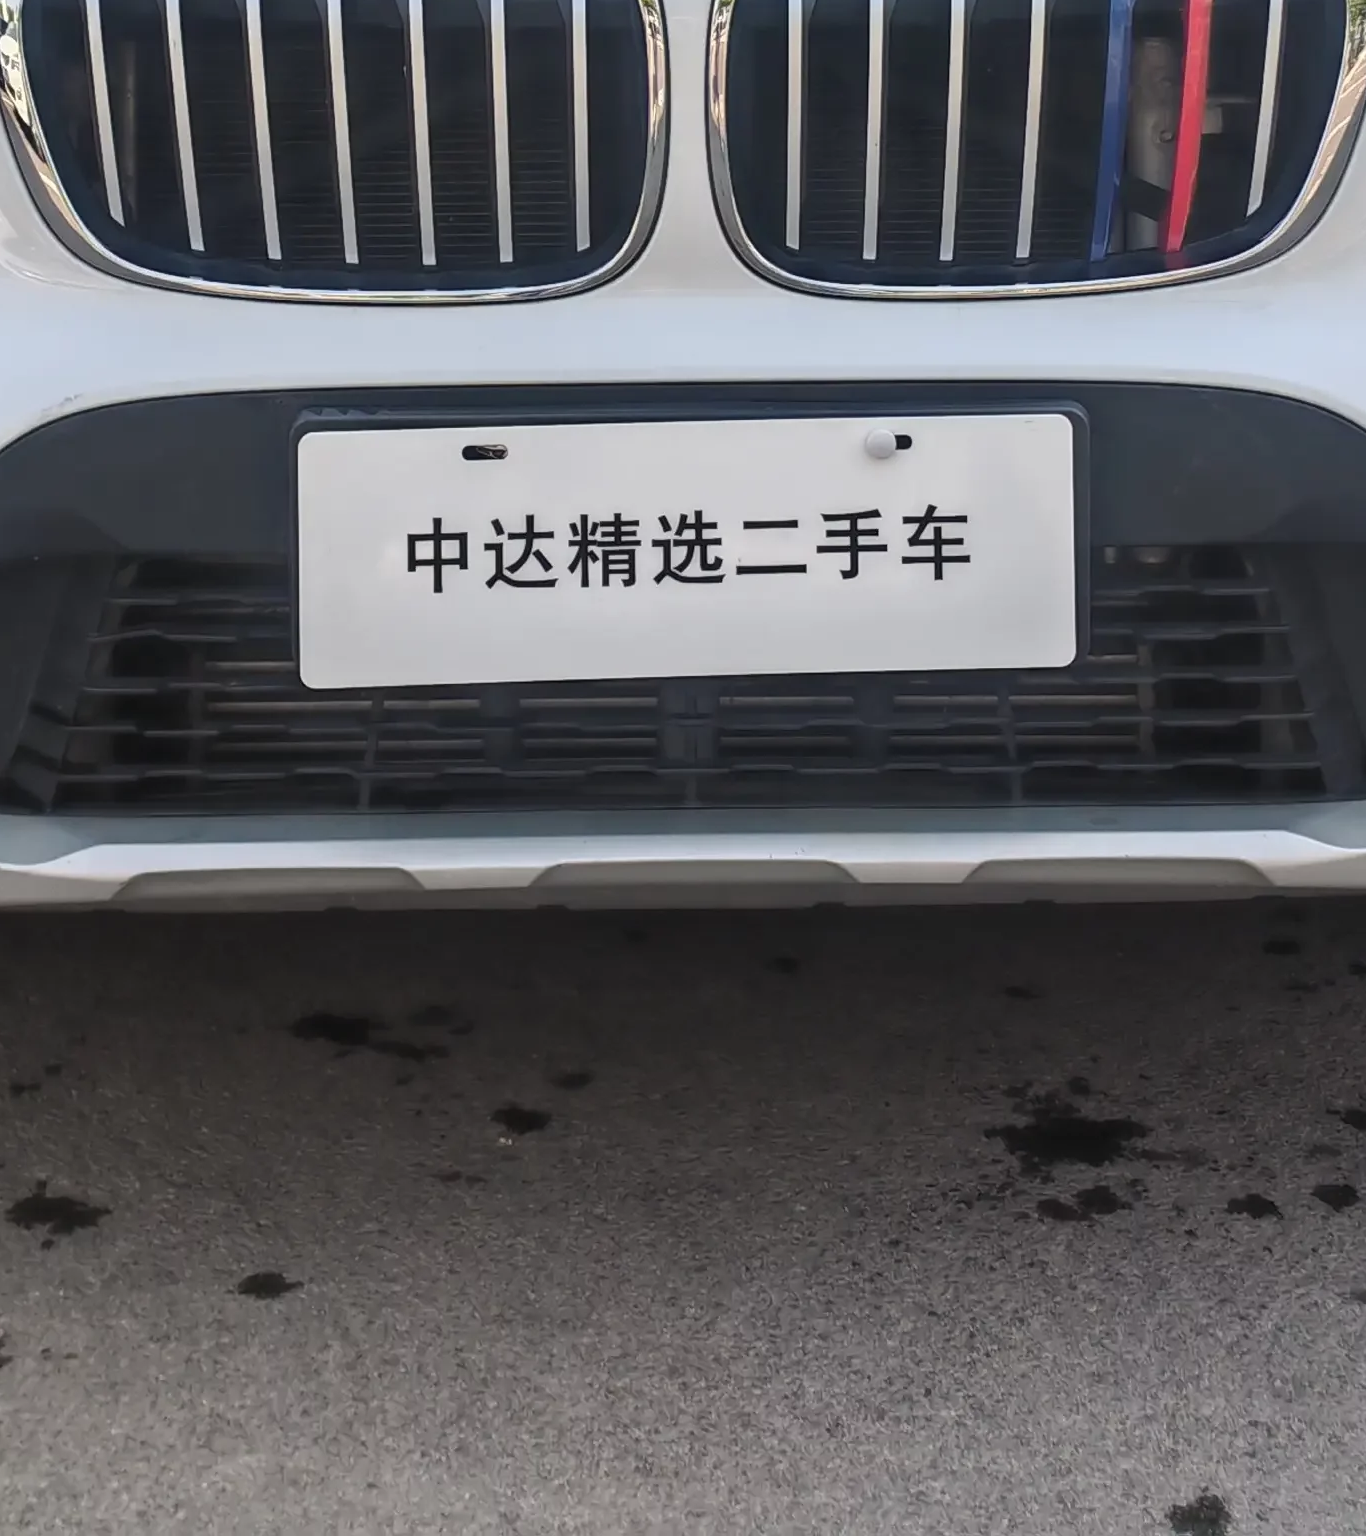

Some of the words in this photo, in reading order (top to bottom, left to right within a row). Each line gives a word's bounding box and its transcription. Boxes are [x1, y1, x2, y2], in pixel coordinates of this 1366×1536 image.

[406, 504, 972, 594] 中达精选二手车
